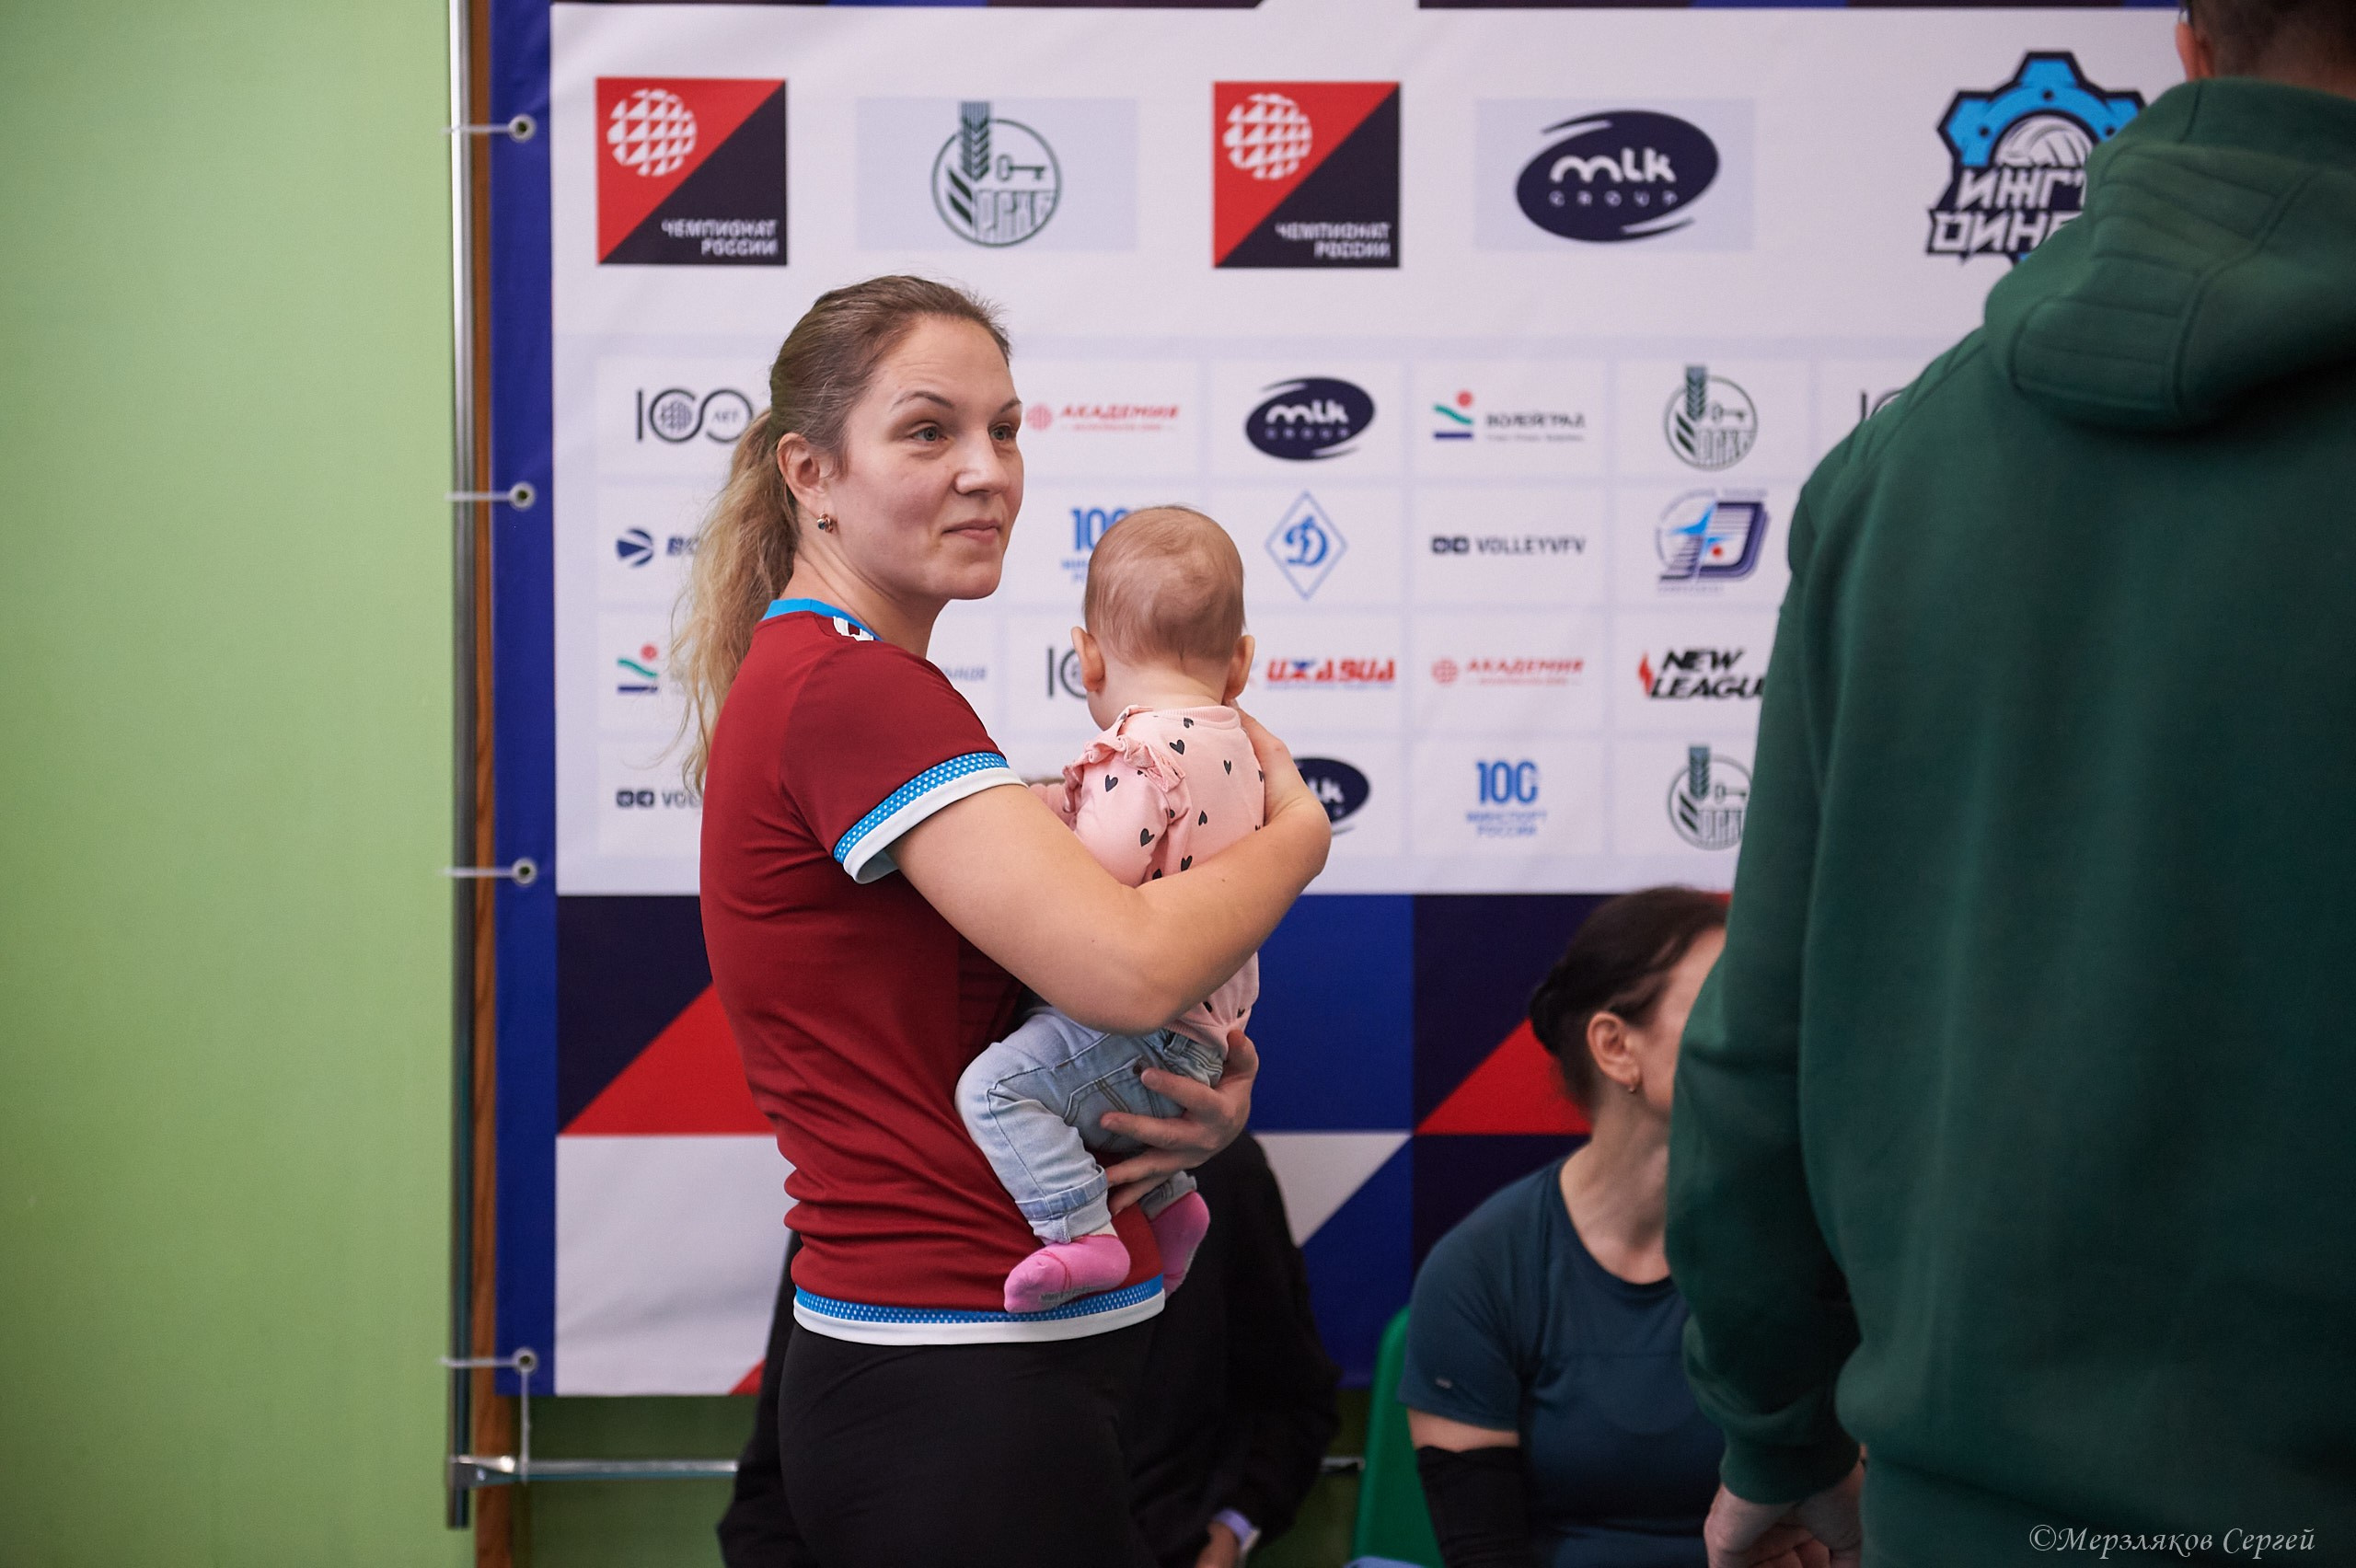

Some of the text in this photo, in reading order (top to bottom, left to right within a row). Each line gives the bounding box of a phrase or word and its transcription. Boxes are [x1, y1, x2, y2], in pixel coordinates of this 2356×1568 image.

[661, 219, 778, 237] ЧЕМПИОНАТ
[700, 237, 779, 257] РОССИИ
[1662, 649, 1745, 671] NEW
